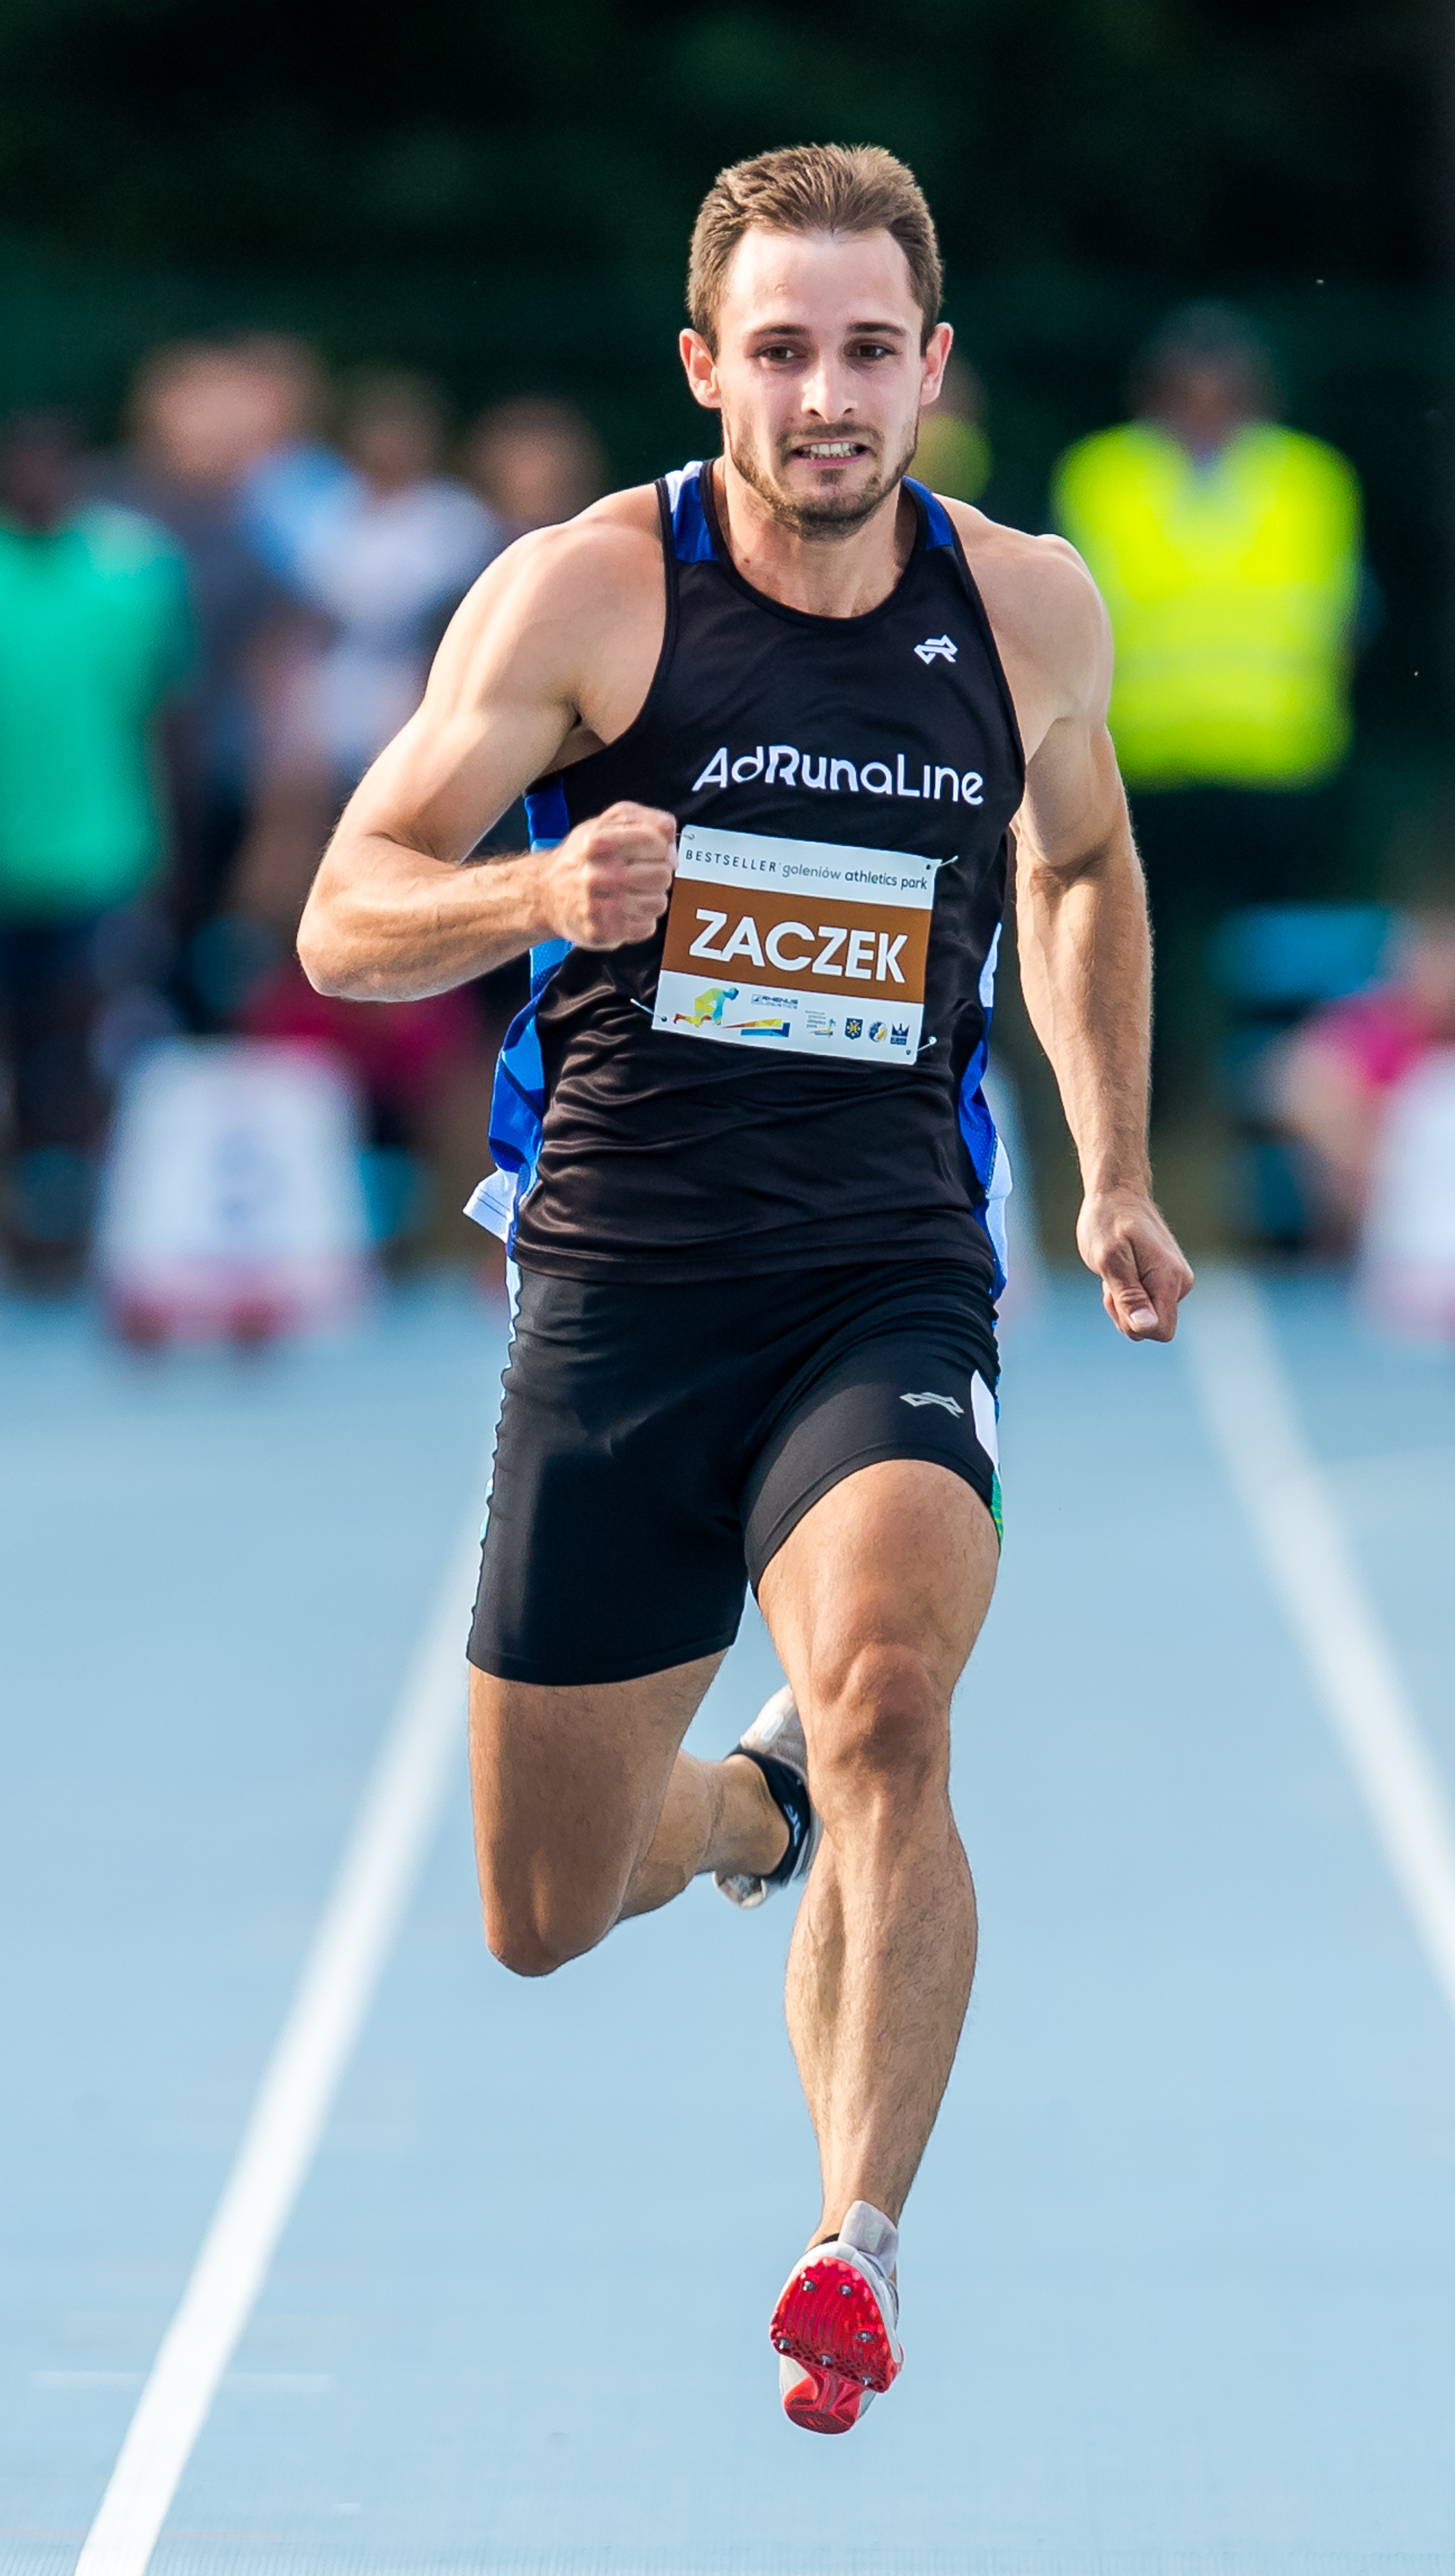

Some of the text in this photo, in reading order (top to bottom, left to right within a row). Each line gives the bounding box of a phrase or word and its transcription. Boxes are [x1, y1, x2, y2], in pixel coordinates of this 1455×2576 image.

[685, 849, 927, 891] BESTSELLER goleniów athletics park
[689, 908, 909, 984] ZACZEK
